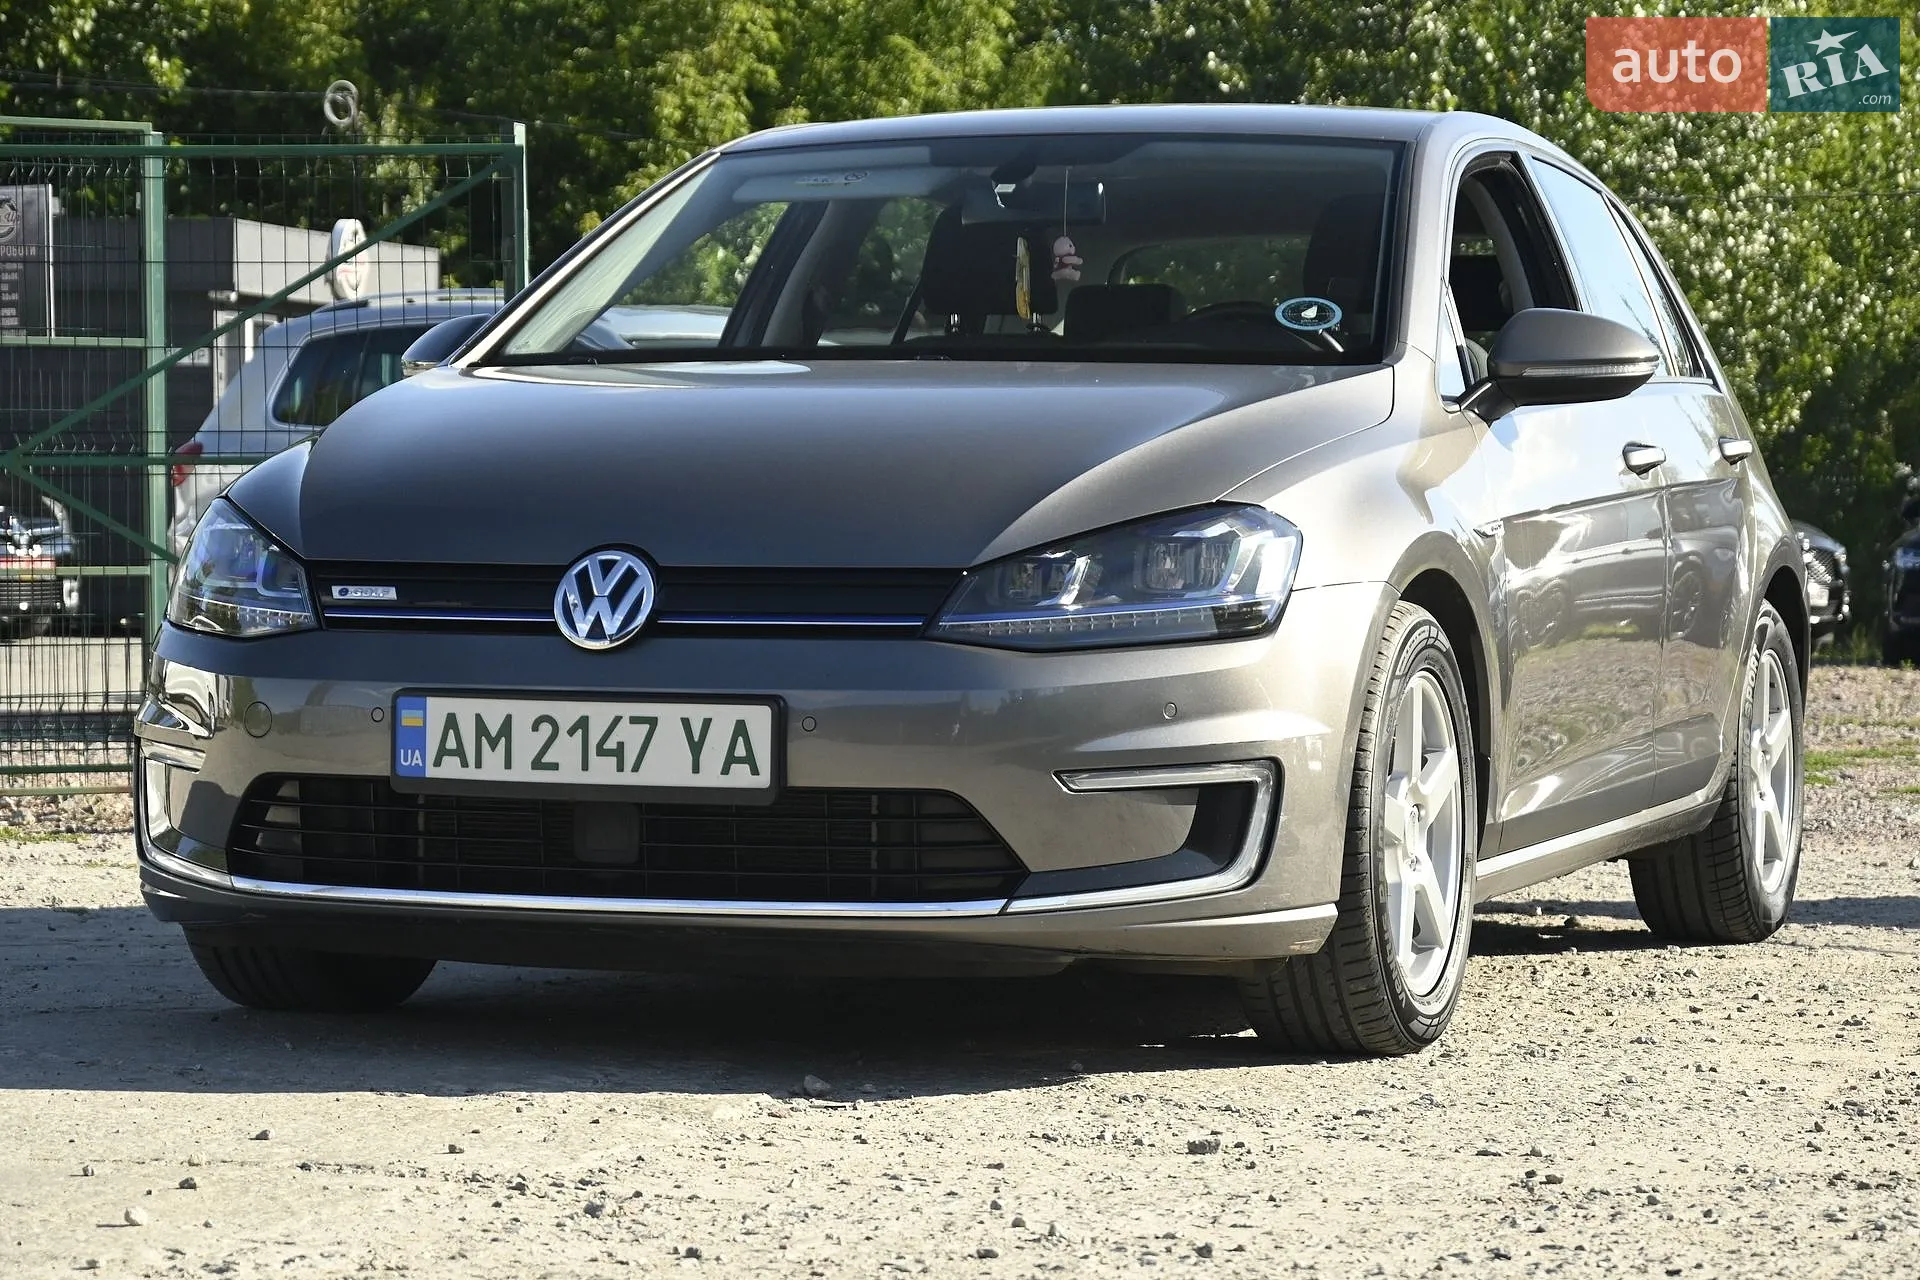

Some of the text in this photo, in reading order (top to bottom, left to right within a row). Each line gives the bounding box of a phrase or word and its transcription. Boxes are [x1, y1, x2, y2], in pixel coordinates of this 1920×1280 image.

[557, 552, 651, 646] VW
[400, 748, 424, 768] UA
[432, 711, 761, 777] AM 2147 YA
